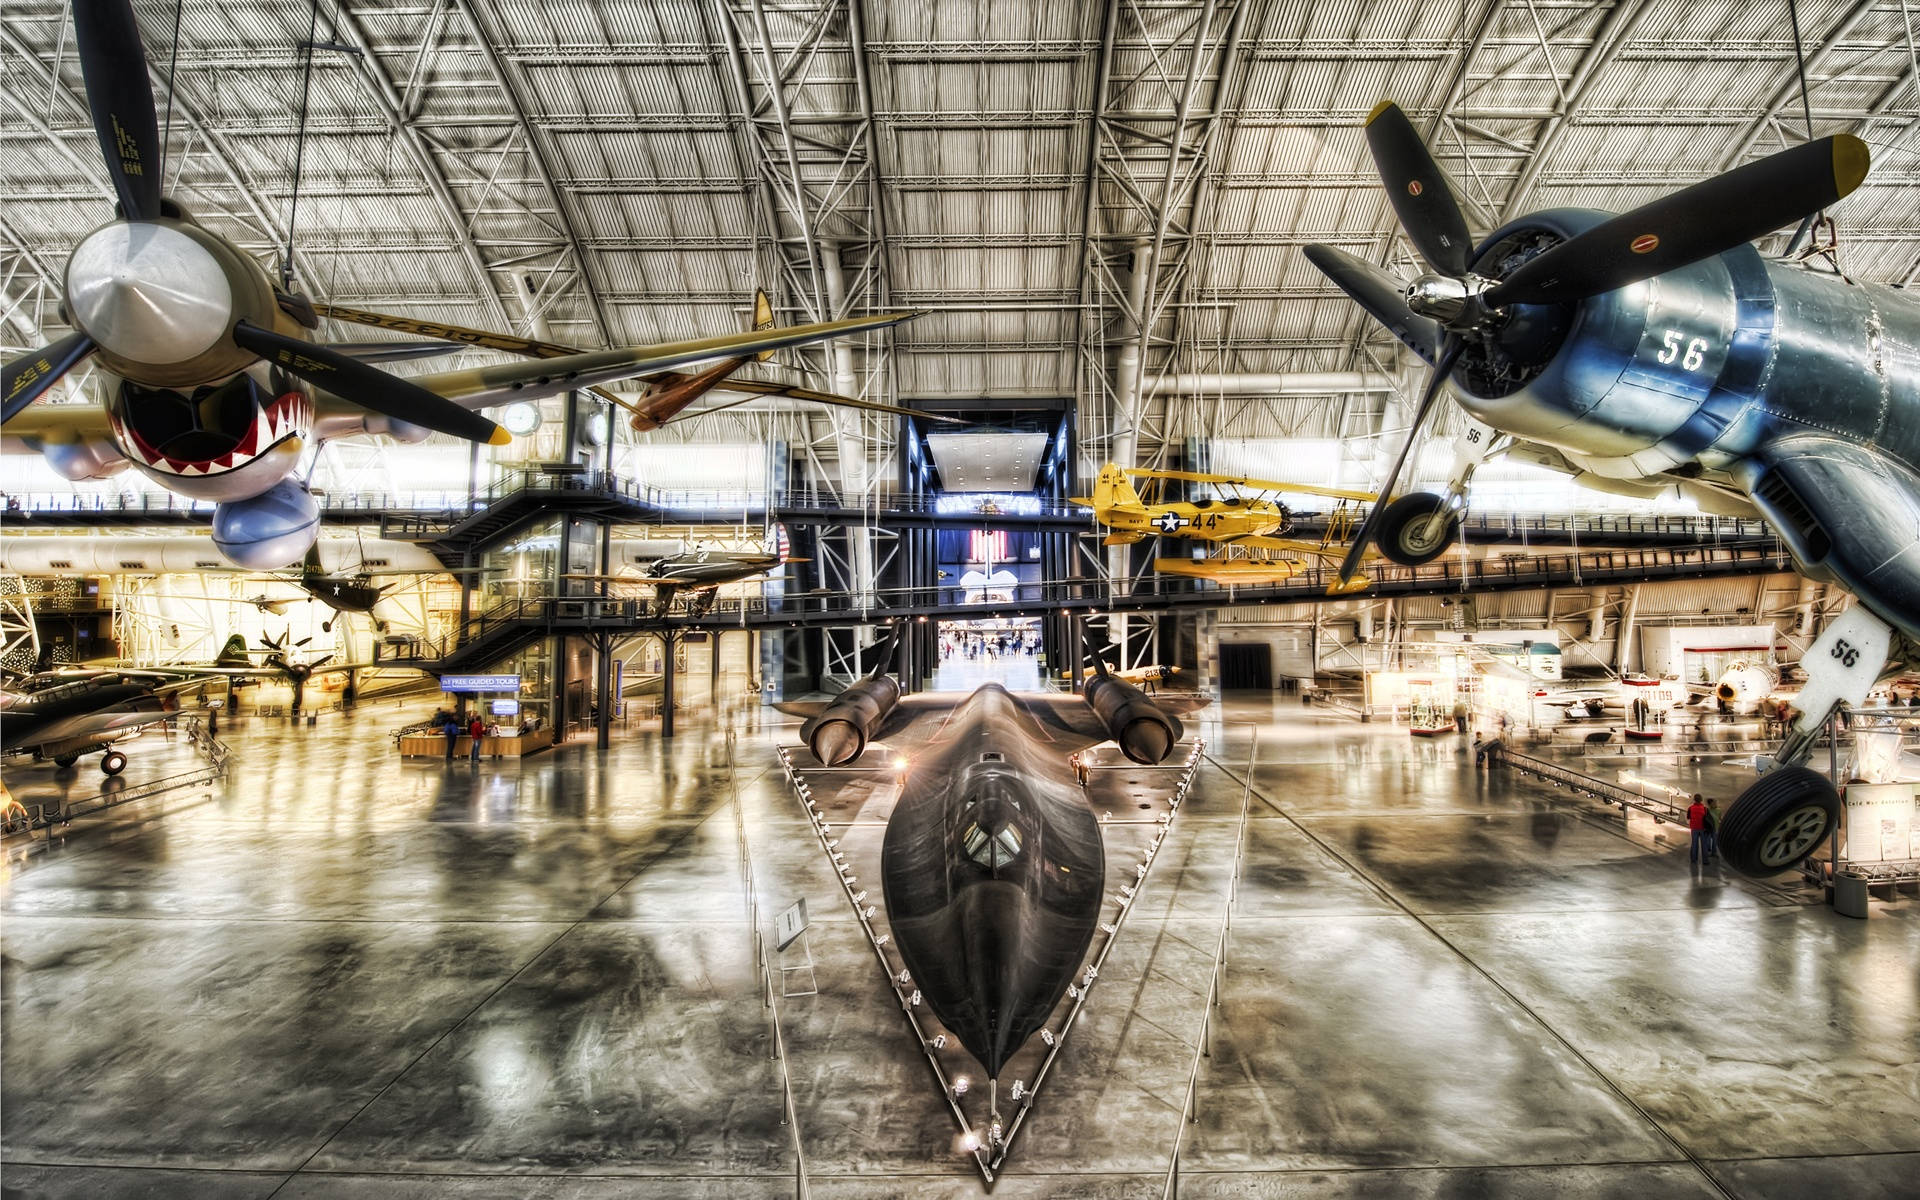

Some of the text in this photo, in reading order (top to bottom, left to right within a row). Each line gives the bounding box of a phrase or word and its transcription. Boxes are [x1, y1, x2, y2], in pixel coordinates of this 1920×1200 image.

[1657, 329, 1708, 372] 56
[1467, 427, 1481, 444] 56
[1191, 513, 1216, 530] 44
[1830, 638, 1860, 668] 56
[1144, 669, 1160, 678] 213
